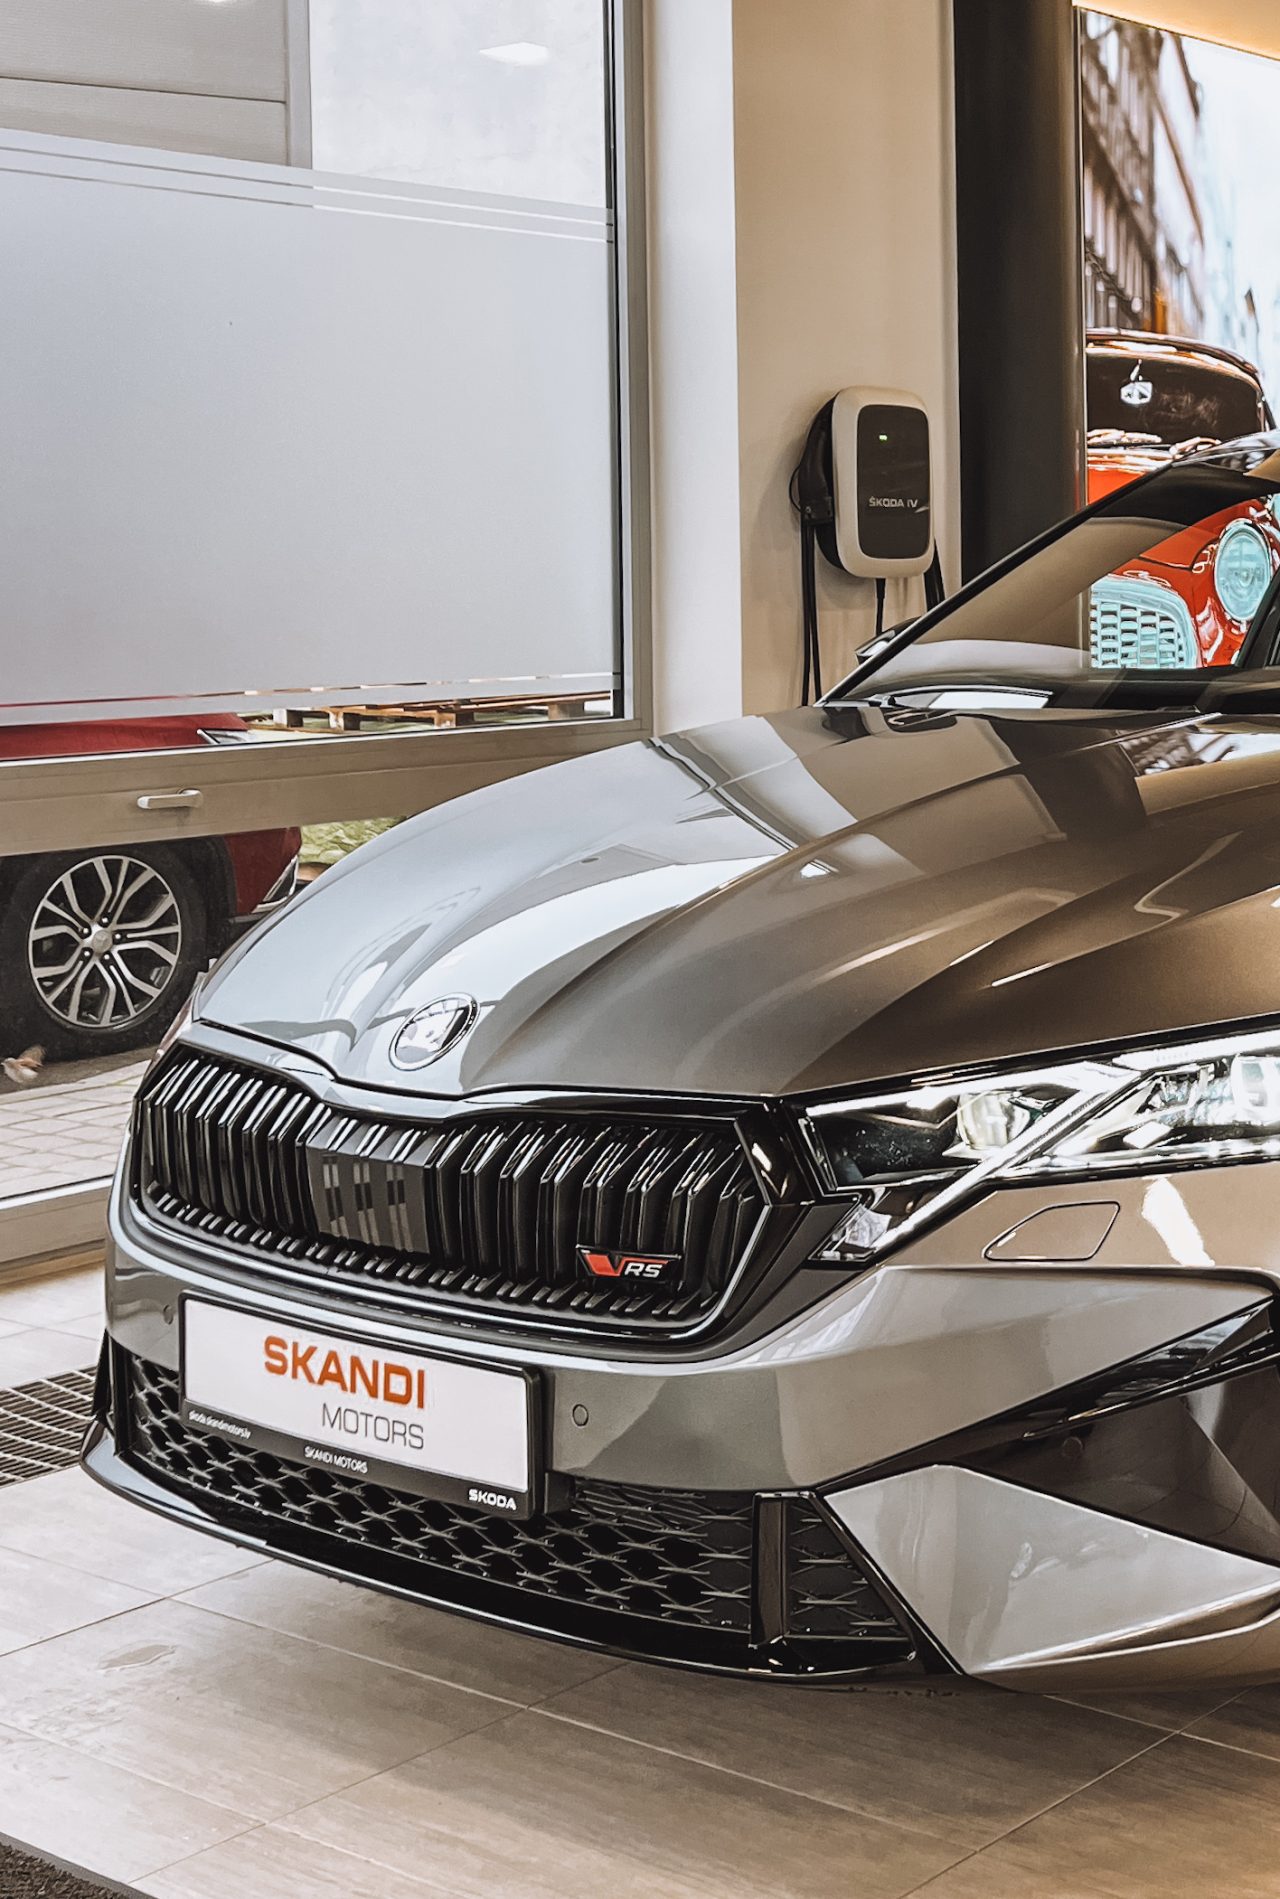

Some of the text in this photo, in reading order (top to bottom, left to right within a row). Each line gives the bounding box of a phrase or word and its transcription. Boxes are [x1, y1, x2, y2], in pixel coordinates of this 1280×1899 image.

[868, 496, 904, 508] ŠKODA
[264, 1335, 425, 1409] SKANDI
[321, 1402, 424, 1451] MOTORS
[304, 1446, 368, 1474] SKANDI MOTORS
